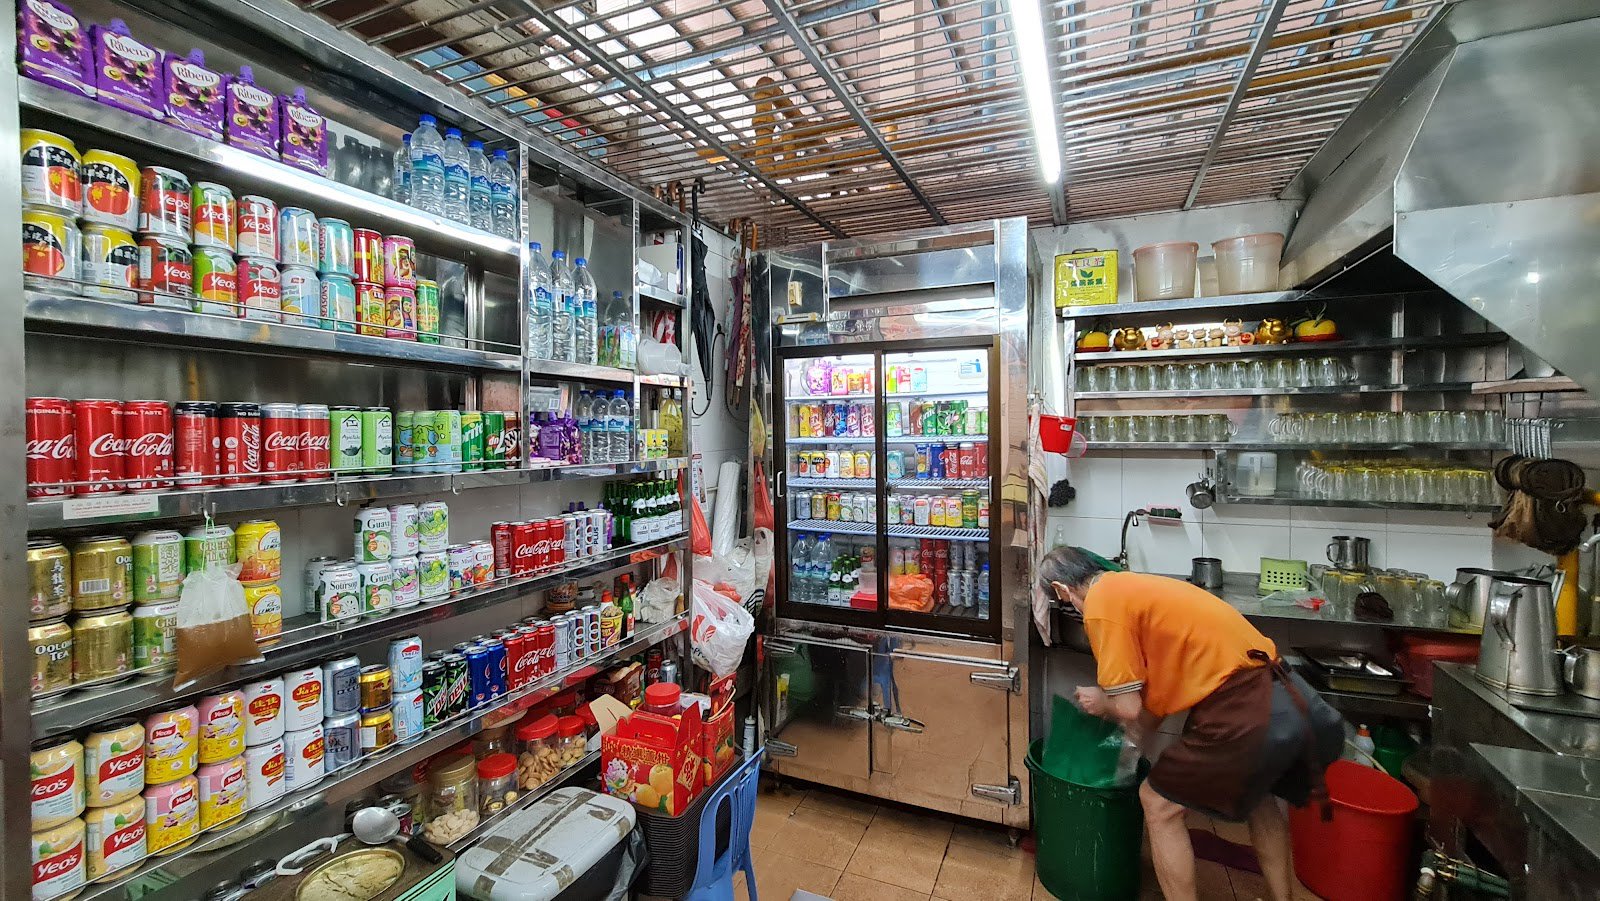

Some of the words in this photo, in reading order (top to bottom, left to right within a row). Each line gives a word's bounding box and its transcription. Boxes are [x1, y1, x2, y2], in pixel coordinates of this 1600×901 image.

[109, 37, 150, 58] Ribena
[176, 66, 214, 83] Ribena
[236, 86, 269, 103] Ribena
[161, 194, 189, 210] Yeo's
[243, 218, 271, 232] Yeo's
[164, 265, 191, 280] Yeo's
[210, 275, 236, 289] Yeo's
[253, 282, 278, 296] Yeo's
[242, 422, 260, 473] Coca-Cola
[49, 650, 69, 661] TEA
[108, 754, 142, 775] Yeo's
[113, 825, 144, 848] Yeo's
[37, 854, 78, 879] Yeo's
